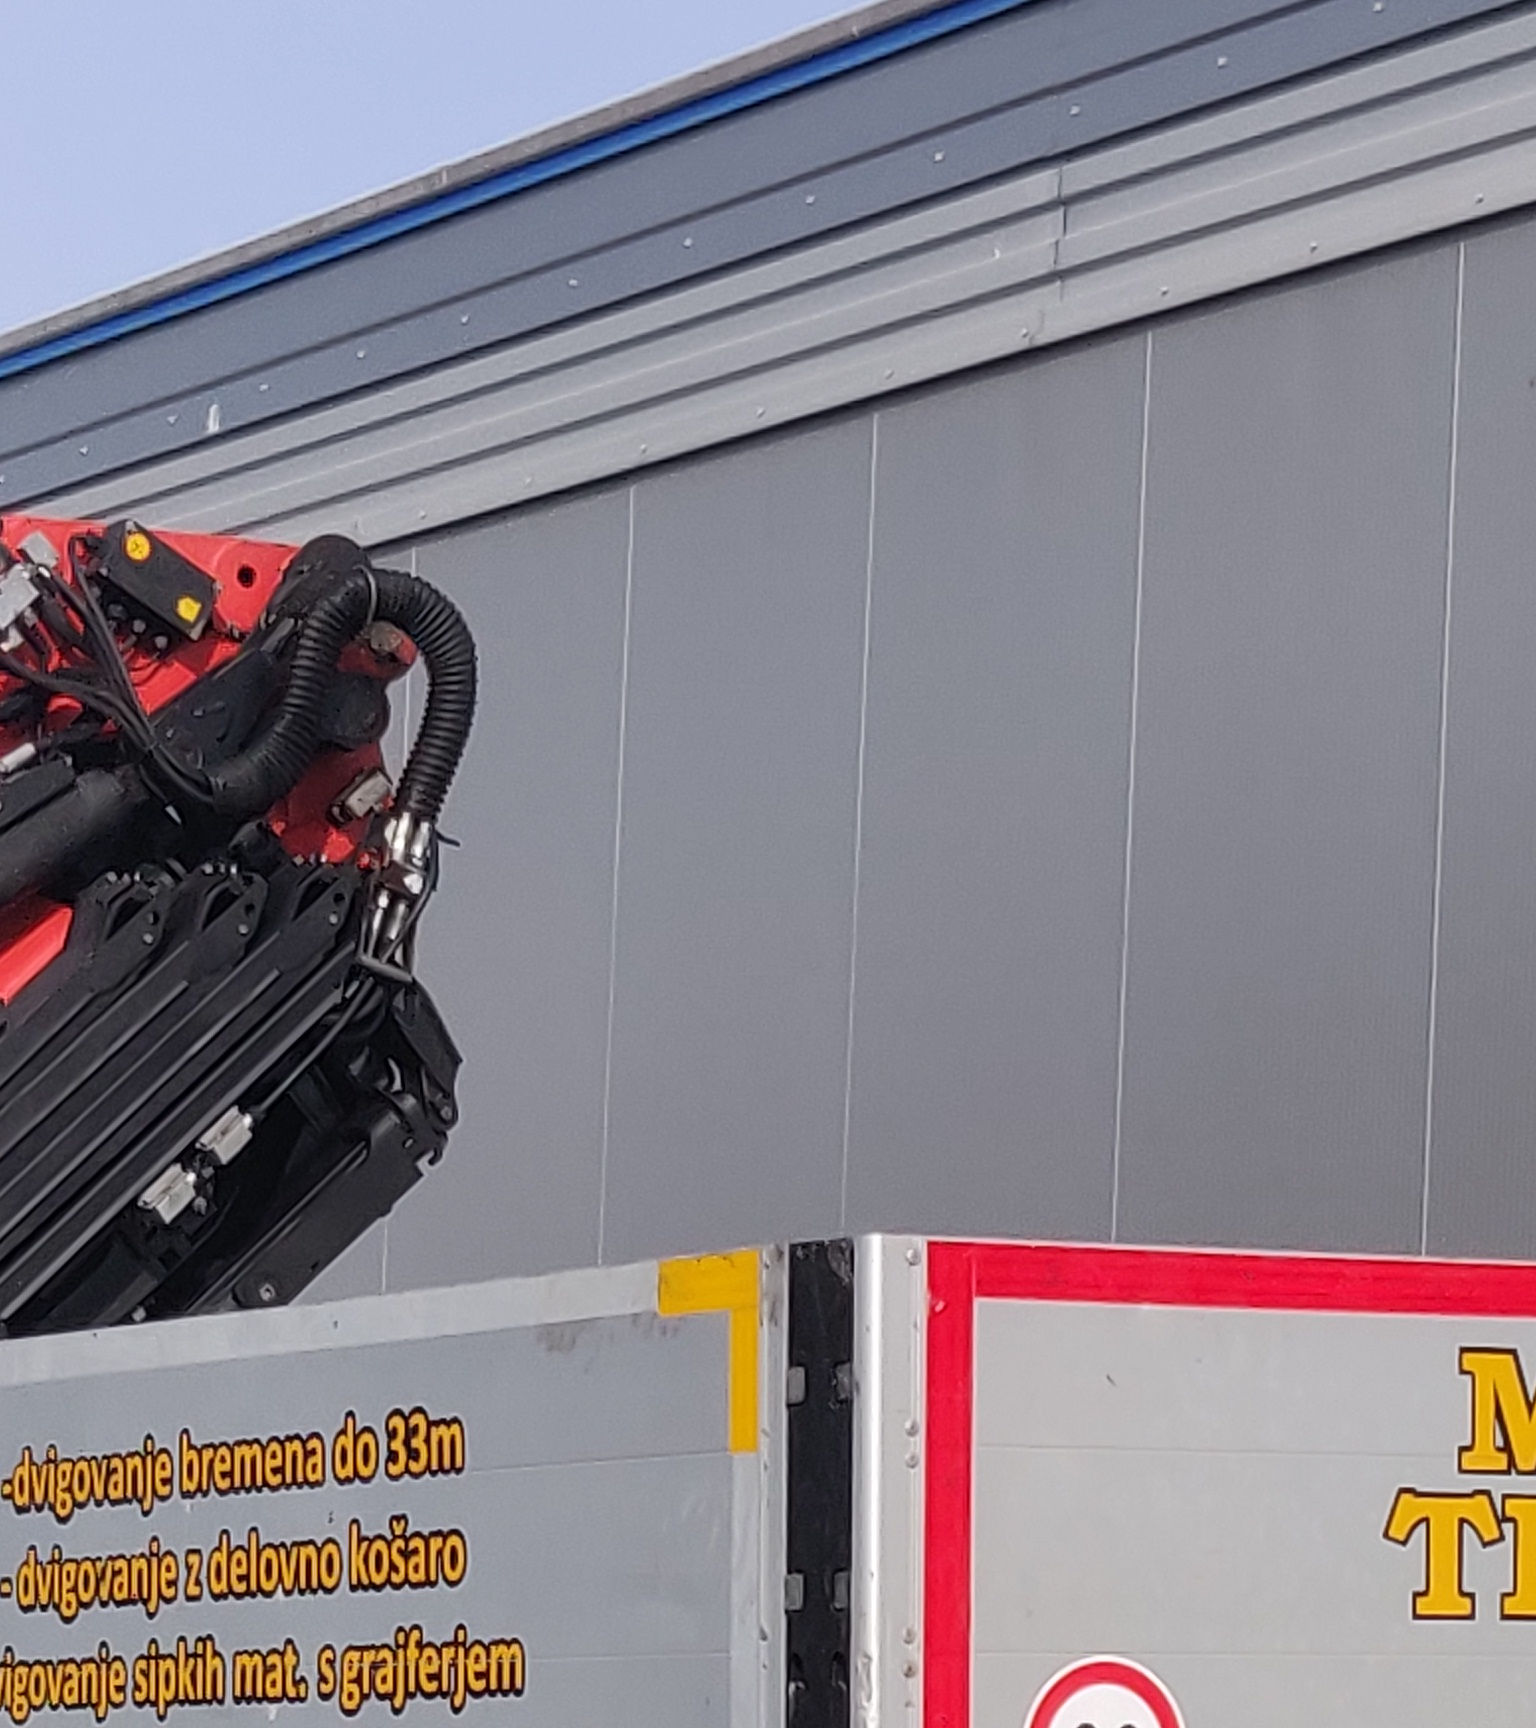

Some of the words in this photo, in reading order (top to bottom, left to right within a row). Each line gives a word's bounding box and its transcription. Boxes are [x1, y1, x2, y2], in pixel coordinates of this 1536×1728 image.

[181, 1421, 325, 1494] bremena
[332, 1411, 379, 1481] do
[385, 1408, 465, 1478] 33m
[16, 1536, 177, 1618] dvigovanje
[185, 1548, 202, 1594] z
[208, 1528, 341, 1601] delovno
[349, 1514, 467, 1589] košaro
[133, 1637, 224, 1718] sipkih
[234, 1638, 307, 1704] mat.
[317, 1647, 337, 1699] s
[341, 1625, 525, 1716] grajferjem
